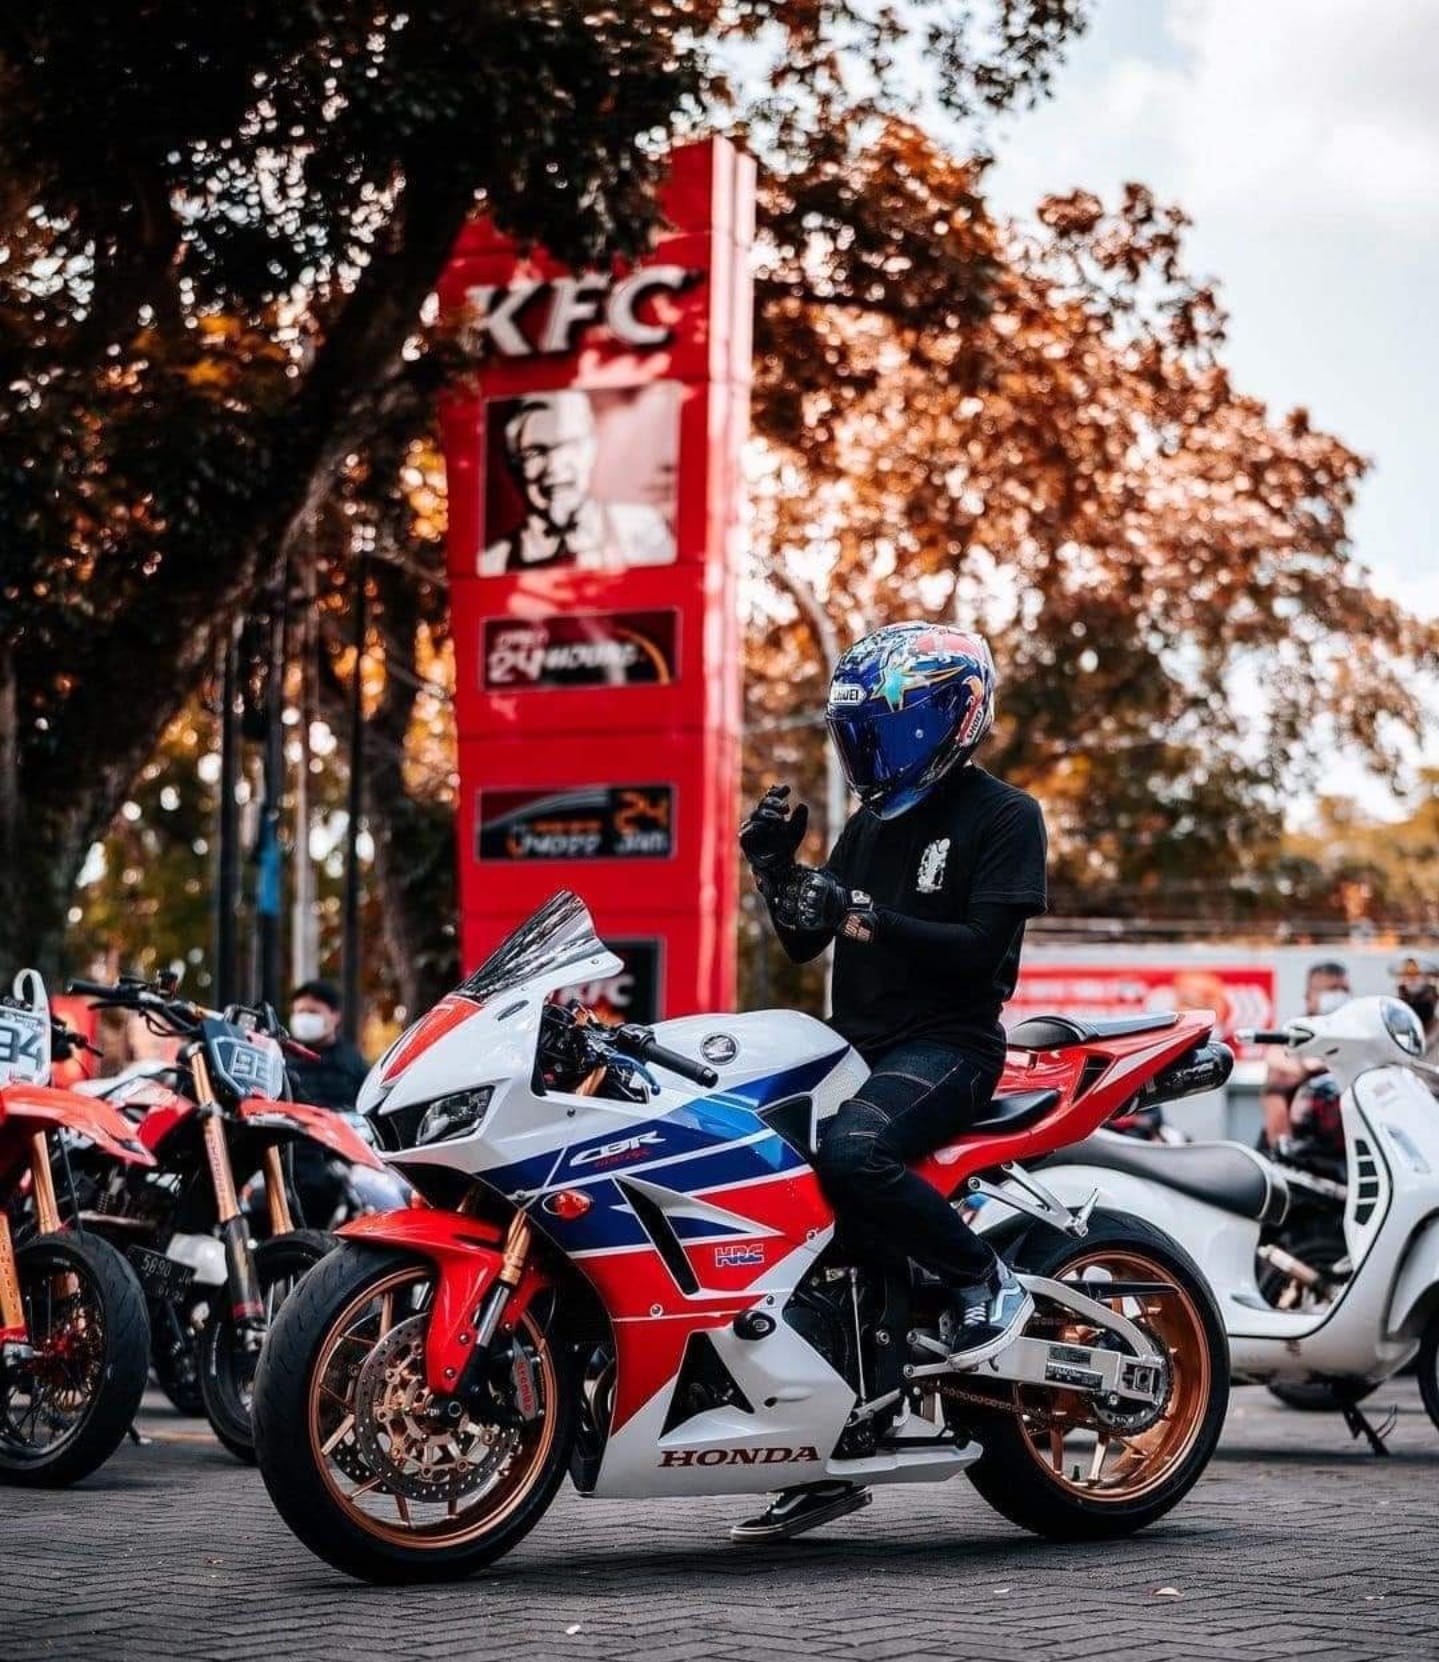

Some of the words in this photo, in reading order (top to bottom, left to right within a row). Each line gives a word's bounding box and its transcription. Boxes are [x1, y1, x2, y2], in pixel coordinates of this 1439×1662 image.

[465, 264, 686, 356] KFC
[569, 1130, 667, 1167] CBR
[715, 1243, 765, 1268] HRC
[657, 1446, 822, 1468] HONDA
